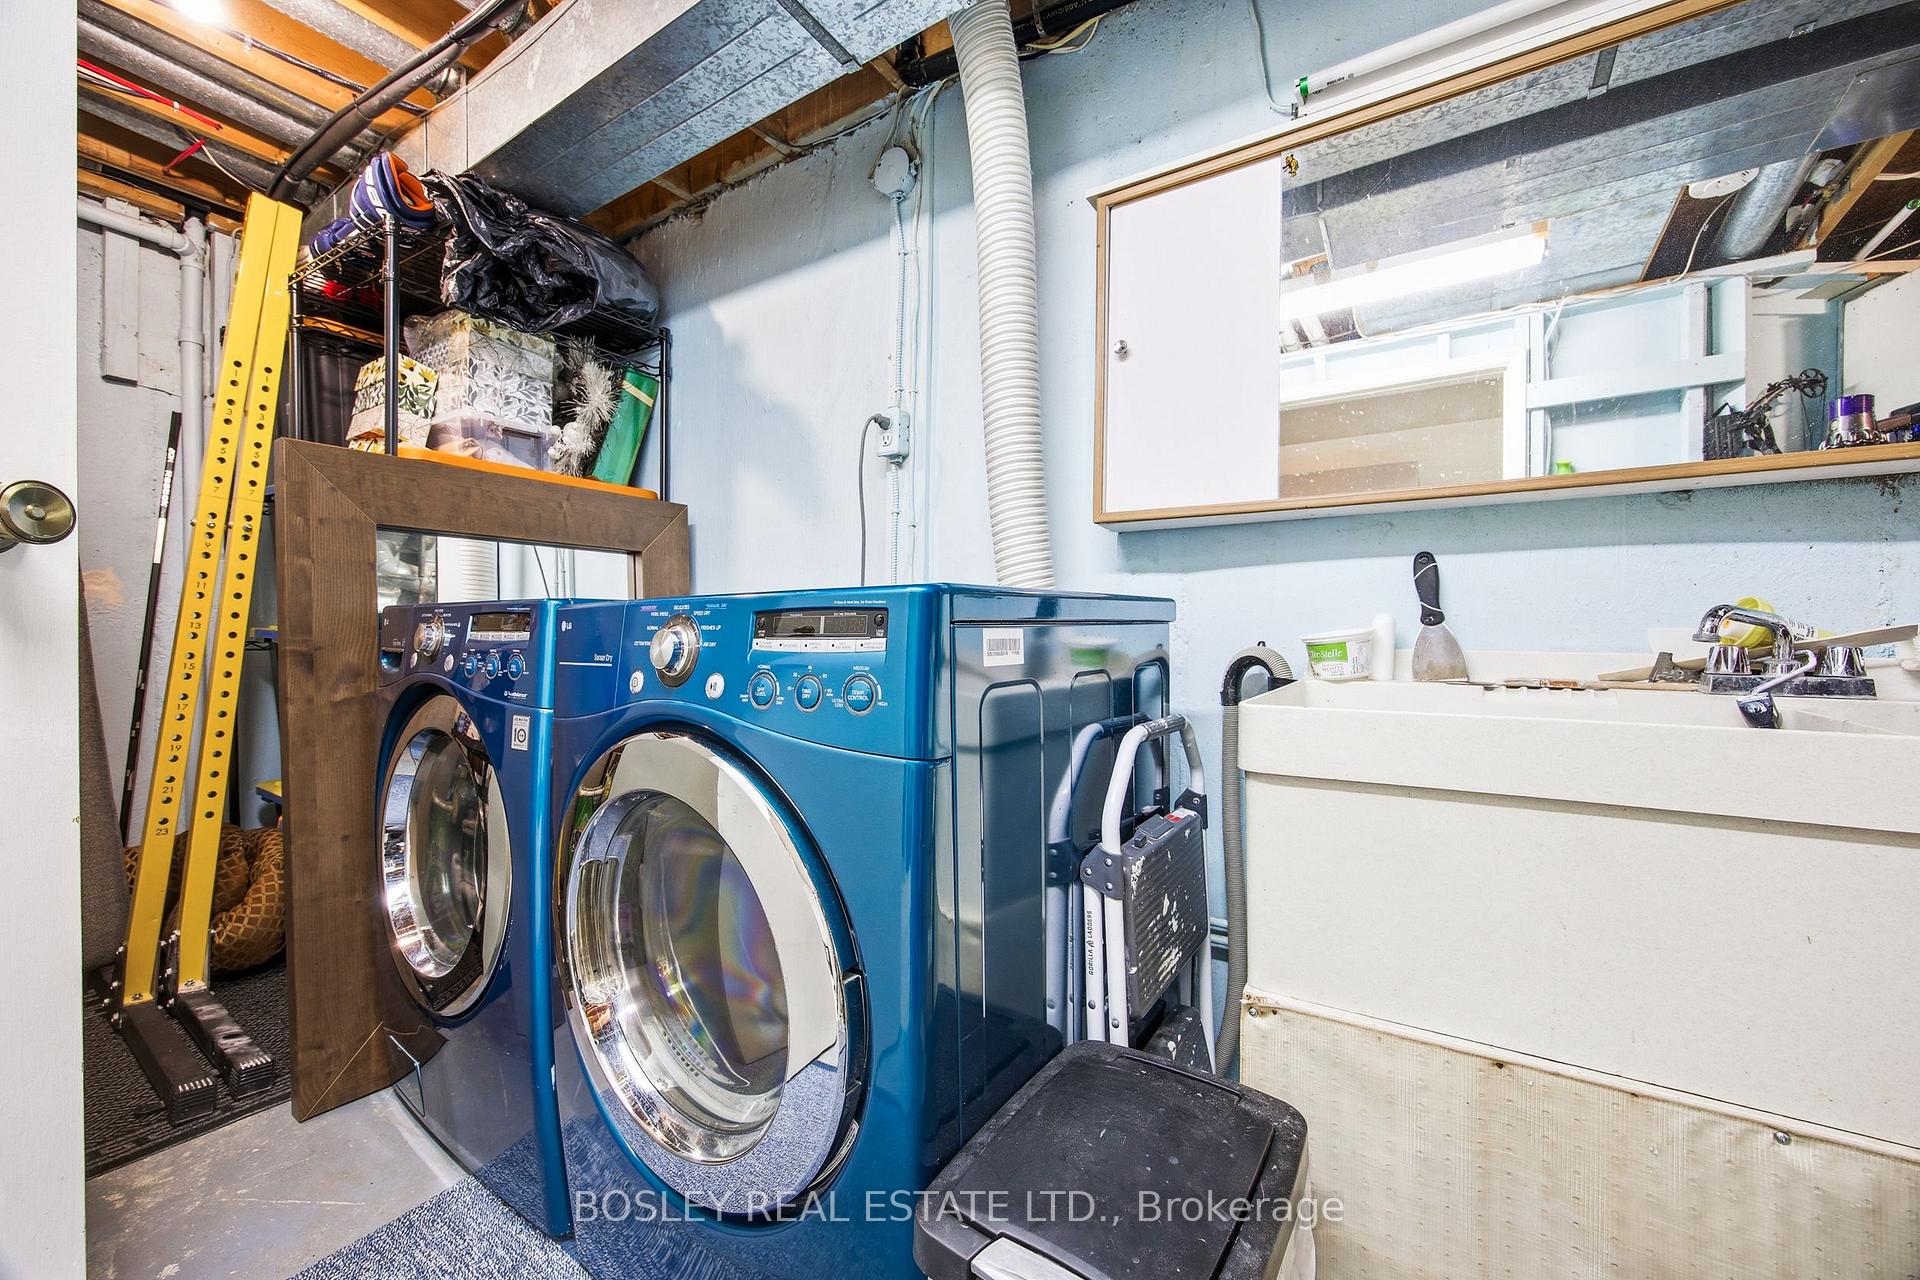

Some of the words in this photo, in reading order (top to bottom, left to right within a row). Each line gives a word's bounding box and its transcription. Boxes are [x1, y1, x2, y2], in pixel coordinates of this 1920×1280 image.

[220, 447, 226, 455] 5
[196, 581, 206, 590] 11
[190, 621, 201, 630] 13
[184, 662, 196, 670] 15
[162, 786, 174, 794] 21
[156, 828, 168, 836] 23
